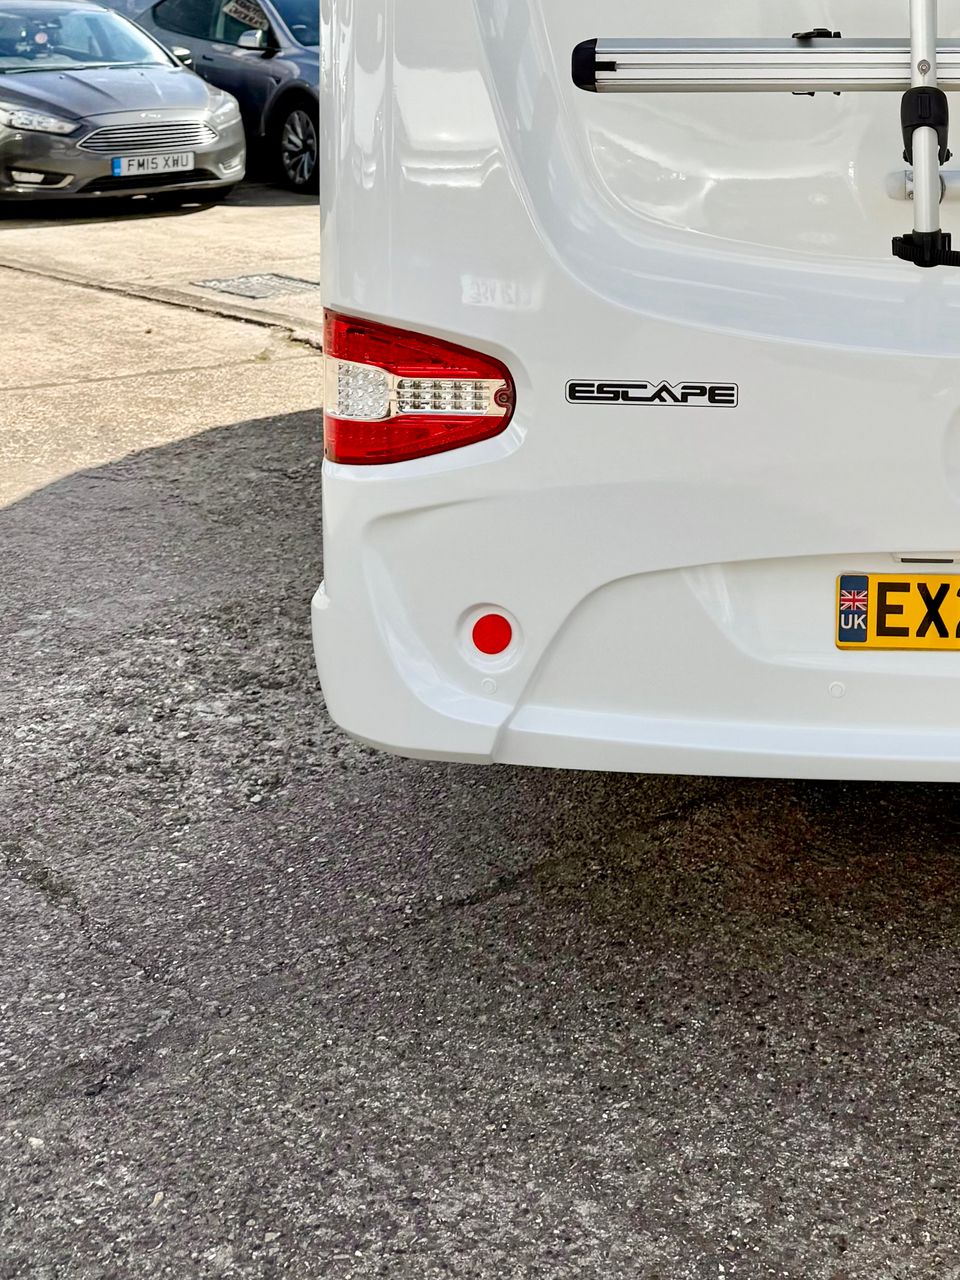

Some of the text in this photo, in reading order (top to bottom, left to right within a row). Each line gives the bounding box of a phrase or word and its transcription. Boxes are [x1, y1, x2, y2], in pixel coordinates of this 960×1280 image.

[127, 154, 189, 172] FM15 XWU
[568, 382, 735, 404] ESCAPE
[840, 613, 867, 630] UK
